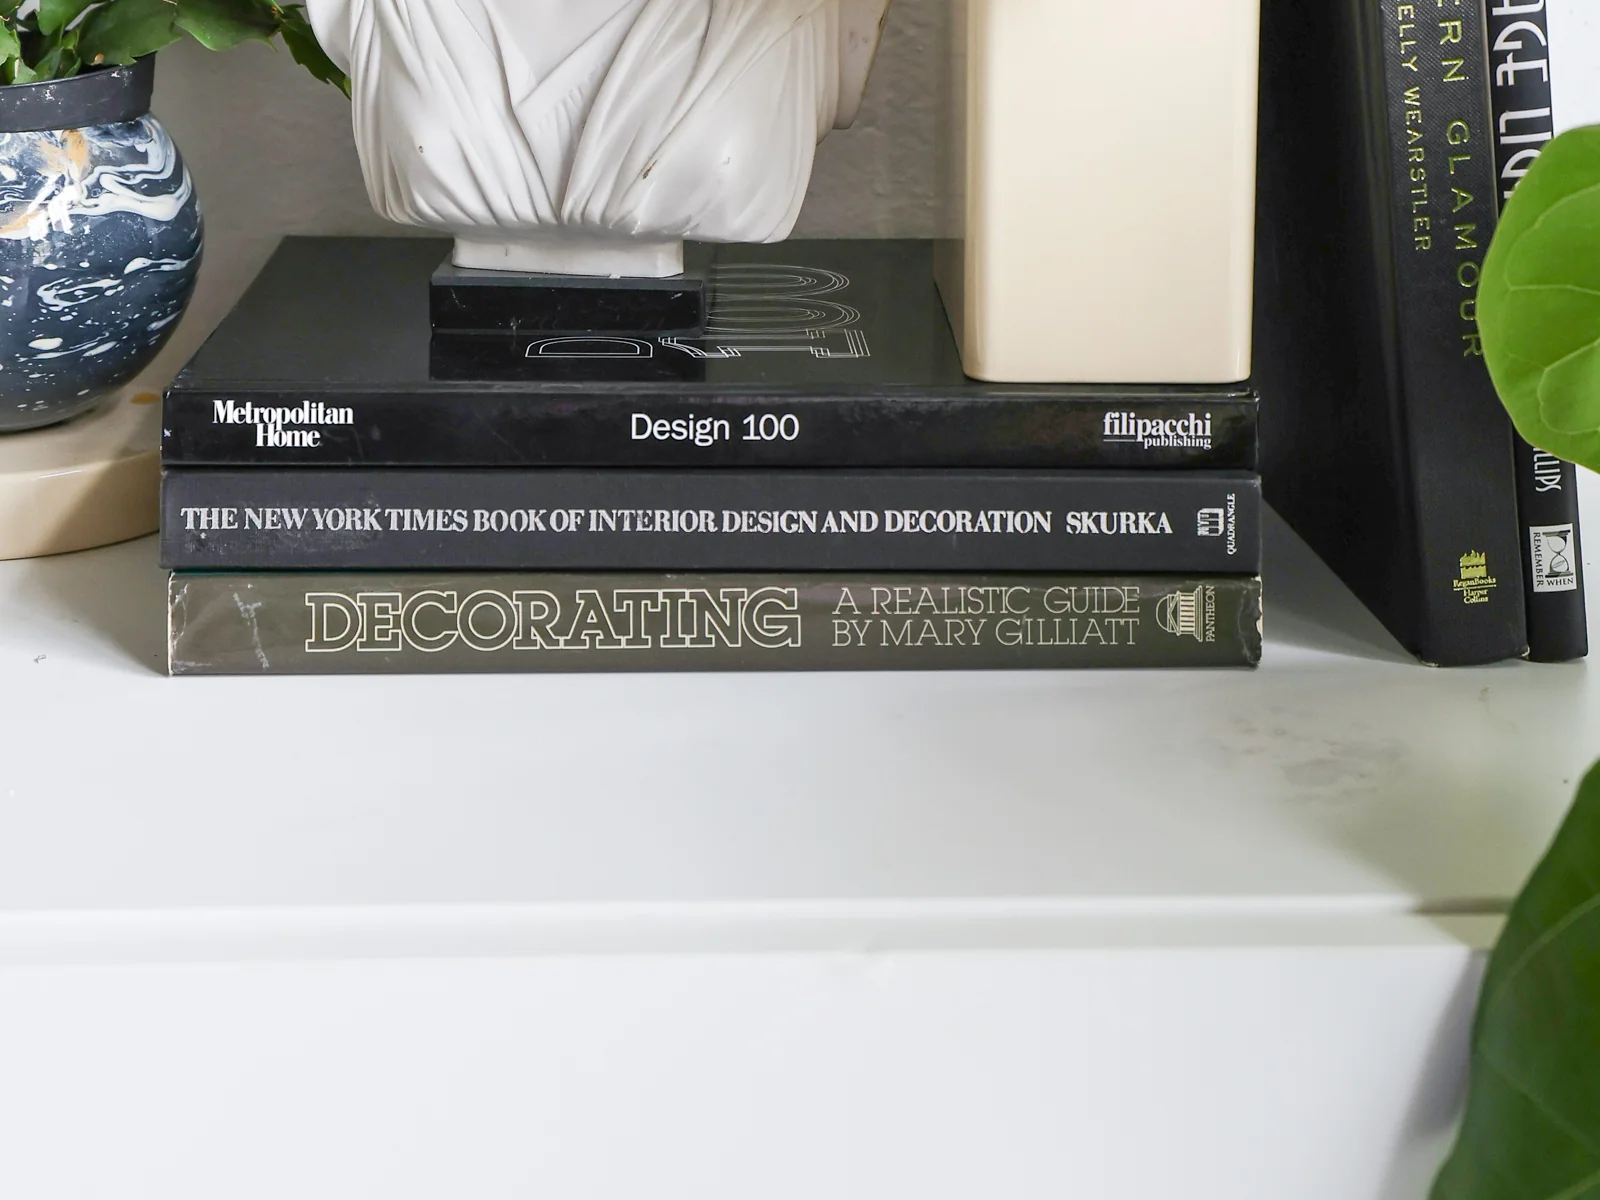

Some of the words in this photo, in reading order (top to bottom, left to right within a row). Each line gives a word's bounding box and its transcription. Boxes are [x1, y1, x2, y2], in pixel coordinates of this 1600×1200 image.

[1403, 86, 1431, 251] WEARSTLER
[1446, 120, 1482, 357] GLAMOUR
[212, 400, 354, 430] Metropolitan
[631, 413, 731, 447] Design
[742, 413, 800, 441] 100
[1103, 412, 1212, 442] filipacchi
[255, 423, 320, 448] Home
[1144, 434, 1212, 450] publishing
[180, 507, 238, 531] THE
[243, 507, 308, 531] NEW
[312, 508, 382, 532] YORK
[385, 508, 467, 532] TIMES
[473, 509, 546, 532] BOOK
[550, 509, 584, 532] OF
[588, 509, 715, 532] INTERIOR
[722, 509, 817, 533] DESIGN
[822, 510, 879, 533] AND
[885, 509, 1052, 533] DECORATION
[1066, 510, 1173, 534] SKURKA
[1227, 493, 1237, 555] QUADRANGLE
[1533, 532, 1544, 587] REMEMBER
[1546, 577, 1574, 587] WHEN
[832, 586, 861, 615] A
[869, 586, 1031, 615] REALISTIC
[1043, 586, 1140, 614] GUIDE
[1205, 585, 1216, 643] PANTHEON
[305, 587, 801, 652] DECORATING
[832, 619, 872, 647] BY
[880, 619, 987, 646] MARY
[995, 619, 1140, 647] GILLIATT
